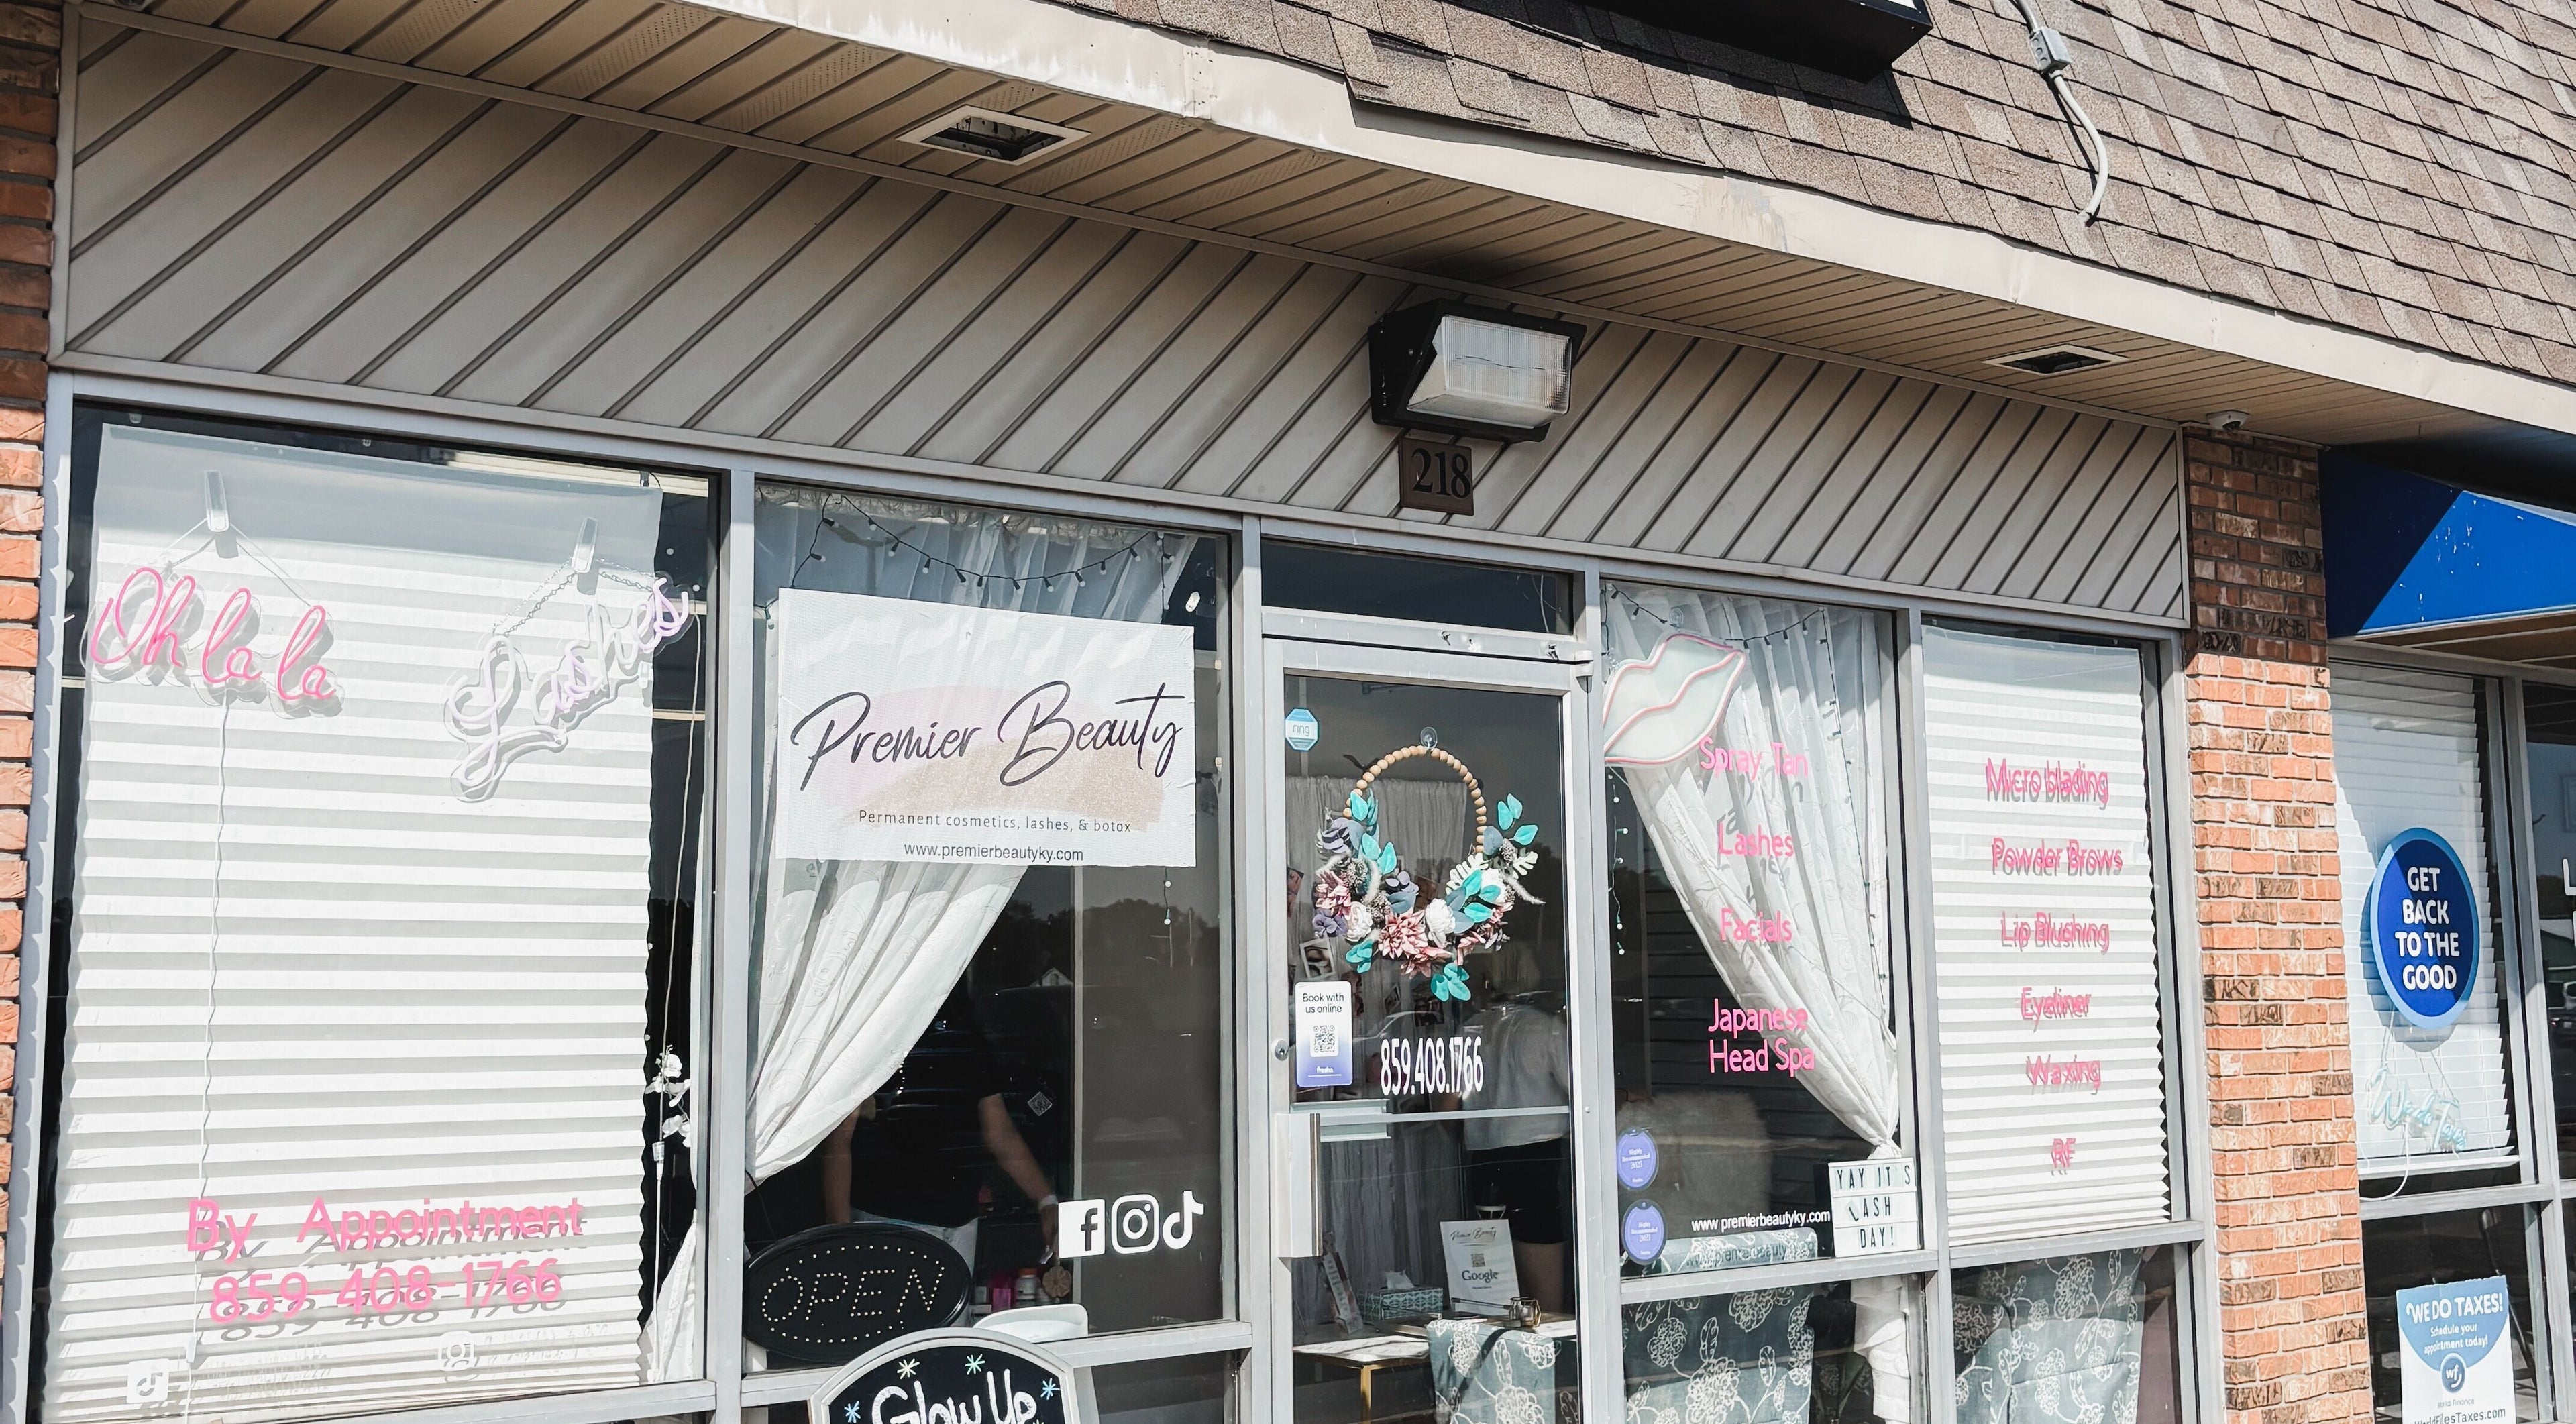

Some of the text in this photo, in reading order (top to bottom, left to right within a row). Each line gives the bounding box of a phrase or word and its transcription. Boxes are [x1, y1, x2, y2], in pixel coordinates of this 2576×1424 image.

[1411, 447, 1471, 499] 218
[90, 567, 337, 701] Oh la la
[449, 577, 689, 787] Lashes
[790, 680, 1185, 791] Premier Beauty
[1293, 724, 1310, 737] ring
[1699, 736, 1809, 781] Spray Tan
[1986, 757, 2042, 797] Micro
[859, 810, 1132, 832] Permanent cosmetics, lashes, & botox
[904, 844, 1083, 863] www.premierbeautyky.com
[1718, 822, 1794, 857] Lashes
[1992, 837, 2123, 872] Powder Brows
[2407, 866, 2440, 891] GET
[1719, 906, 1793, 943] Facials
[2402, 899, 2449, 924] BACK
[2002, 911, 2110, 953] Lip Blushing
[2394, 931, 2460, 957] TO THE
[2402, 964, 2457, 991] GOOD
[1303, 992, 1344, 1002] Book with
[1317, 1003, 1342, 1013] online
[2021, 987, 2092, 1028] Eyeliner
[1708, 998, 1809, 1039] Japanese
[1381, 1036, 1484, 1095] 859.408.1766
[1709, 1037, 1815, 1077] Head Spa
[2026, 1055, 2101, 1093] Waxing
[1837, 1168, 1864, 1189] YAY
[1849, 1196, 1891, 1222] LASH
[186, 1197, 584, 1264] By Appointment
[1860, 1226, 1894, 1248] DAY!
[209, 1257, 562, 1325] 859-408-1766
[1462, 1268, 1499, 1284] Google
[762, 1268, 943, 1321] OPEN
[2406, 1292, 2504, 1325] WE DO TAXES!
[2430, 1323, 2478, 1337] Schedule your
[2465, 1334, 2489, 1348] today!
[871, 1368, 1037, 1424] Glow Up
